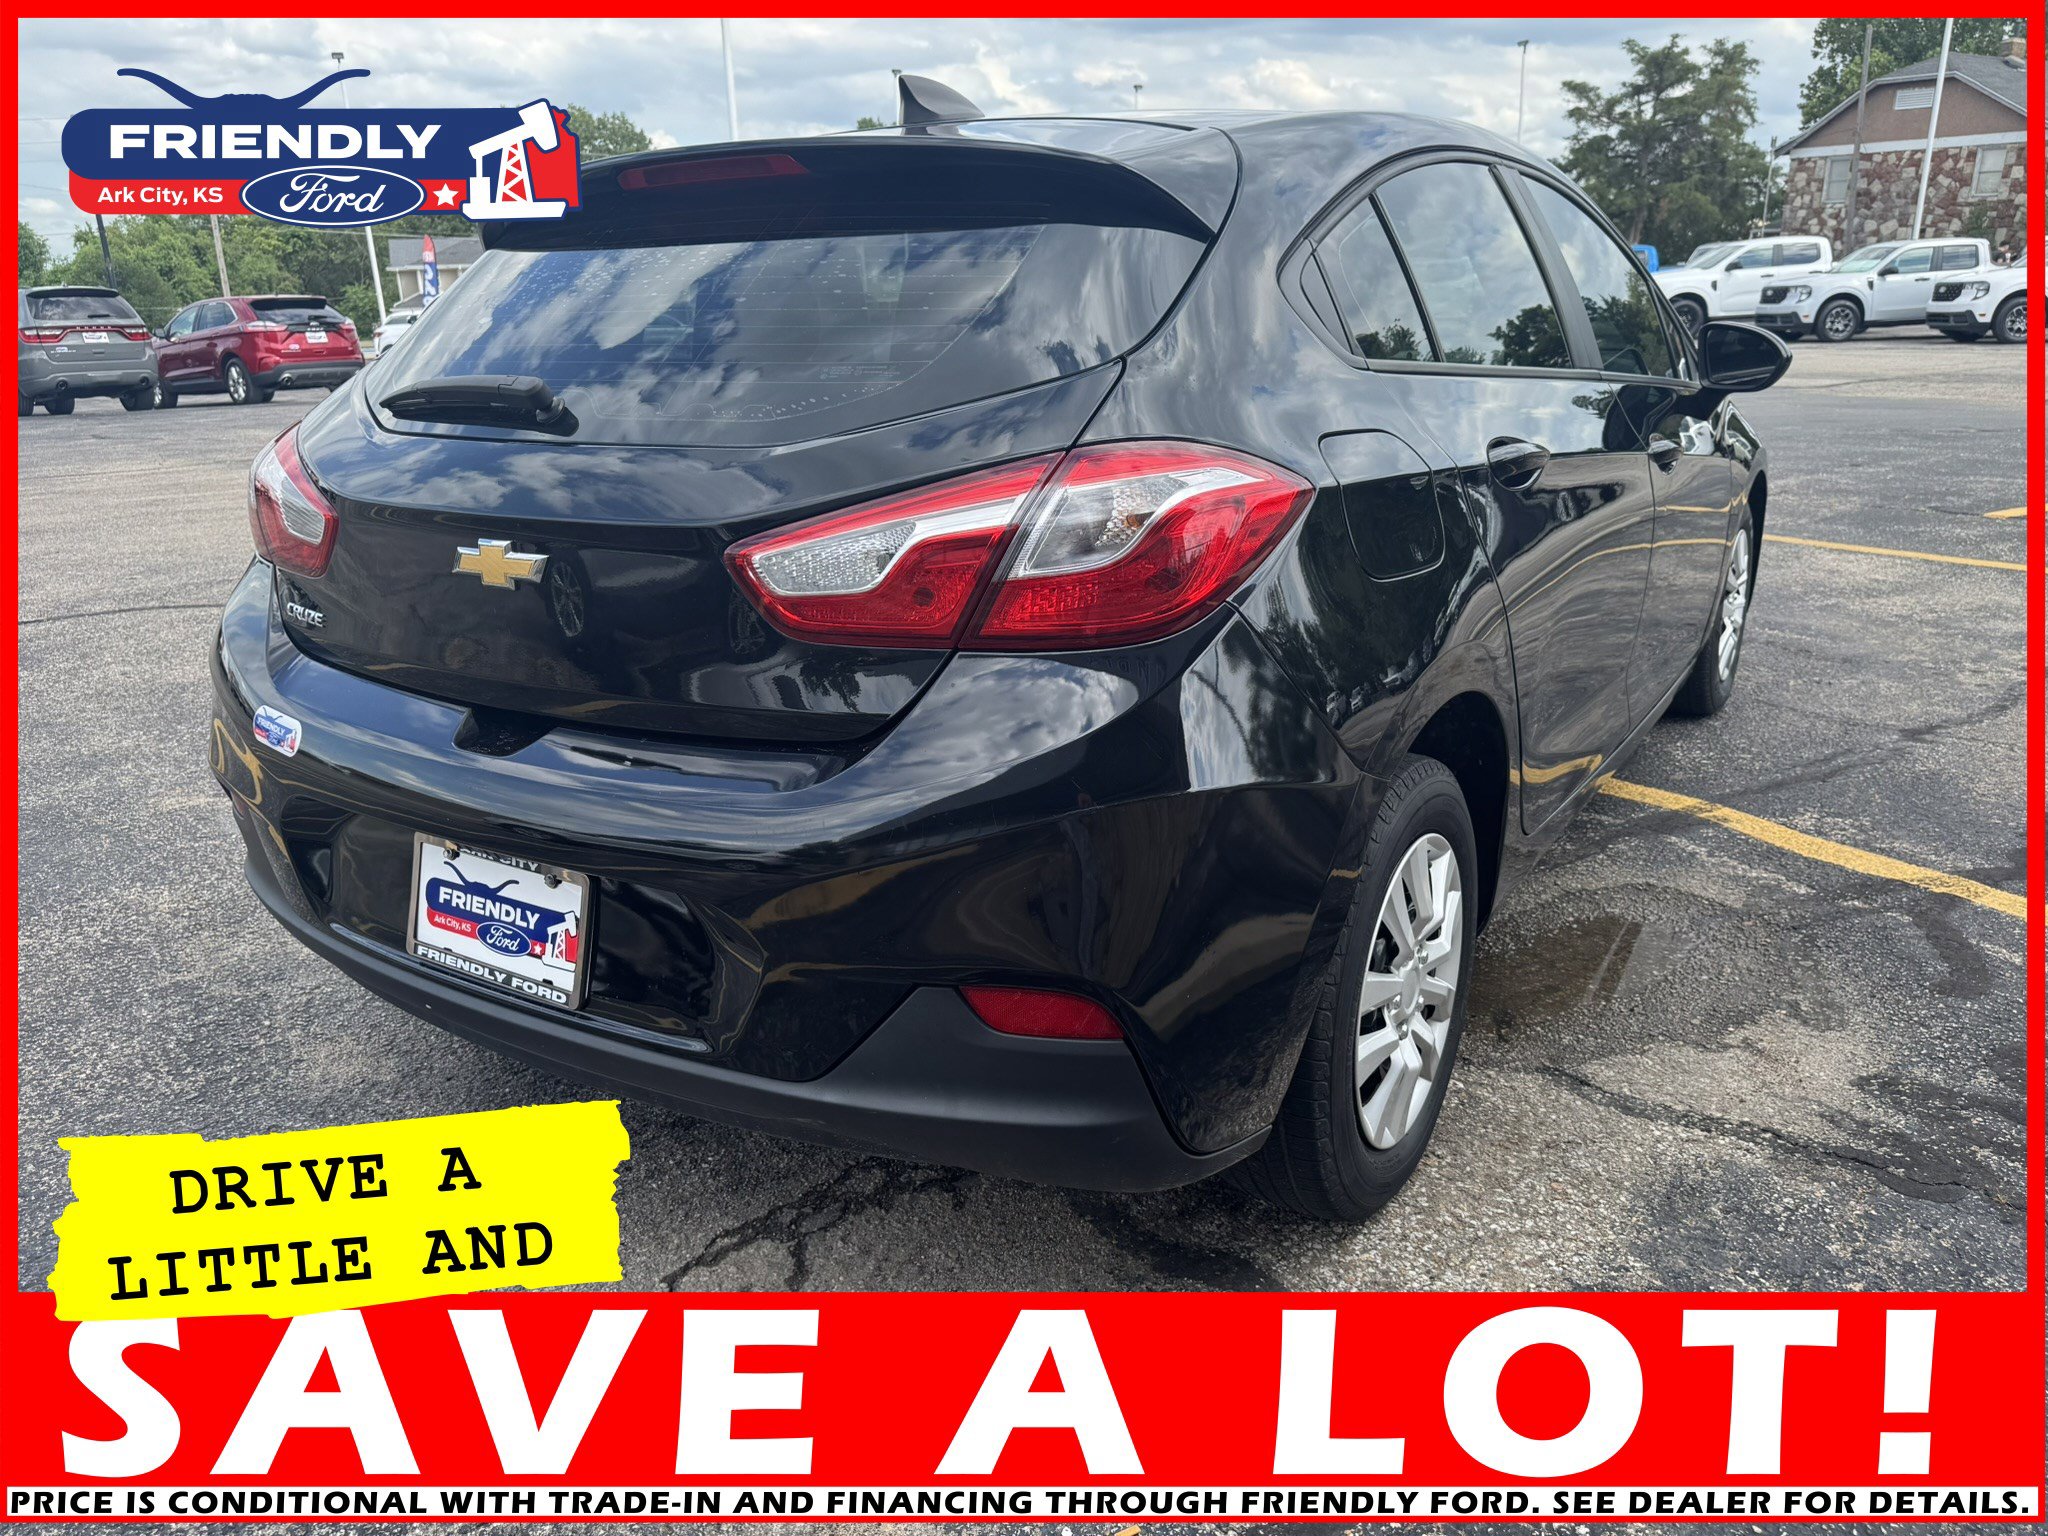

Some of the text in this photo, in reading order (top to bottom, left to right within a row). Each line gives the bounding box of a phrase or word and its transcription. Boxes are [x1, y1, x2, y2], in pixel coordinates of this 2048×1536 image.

[287, 602, 324, 627] CRUZE
[257, 717, 286, 736] FRIENDLY
[500, 857, 539, 871] CITY
[438, 886, 541, 930] FRIENDLY
[434, 915, 472, 932] Ark City, KS
[487, 925, 520, 952] Ford
[417, 945, 567, 1004] FRIENDLY FORD
